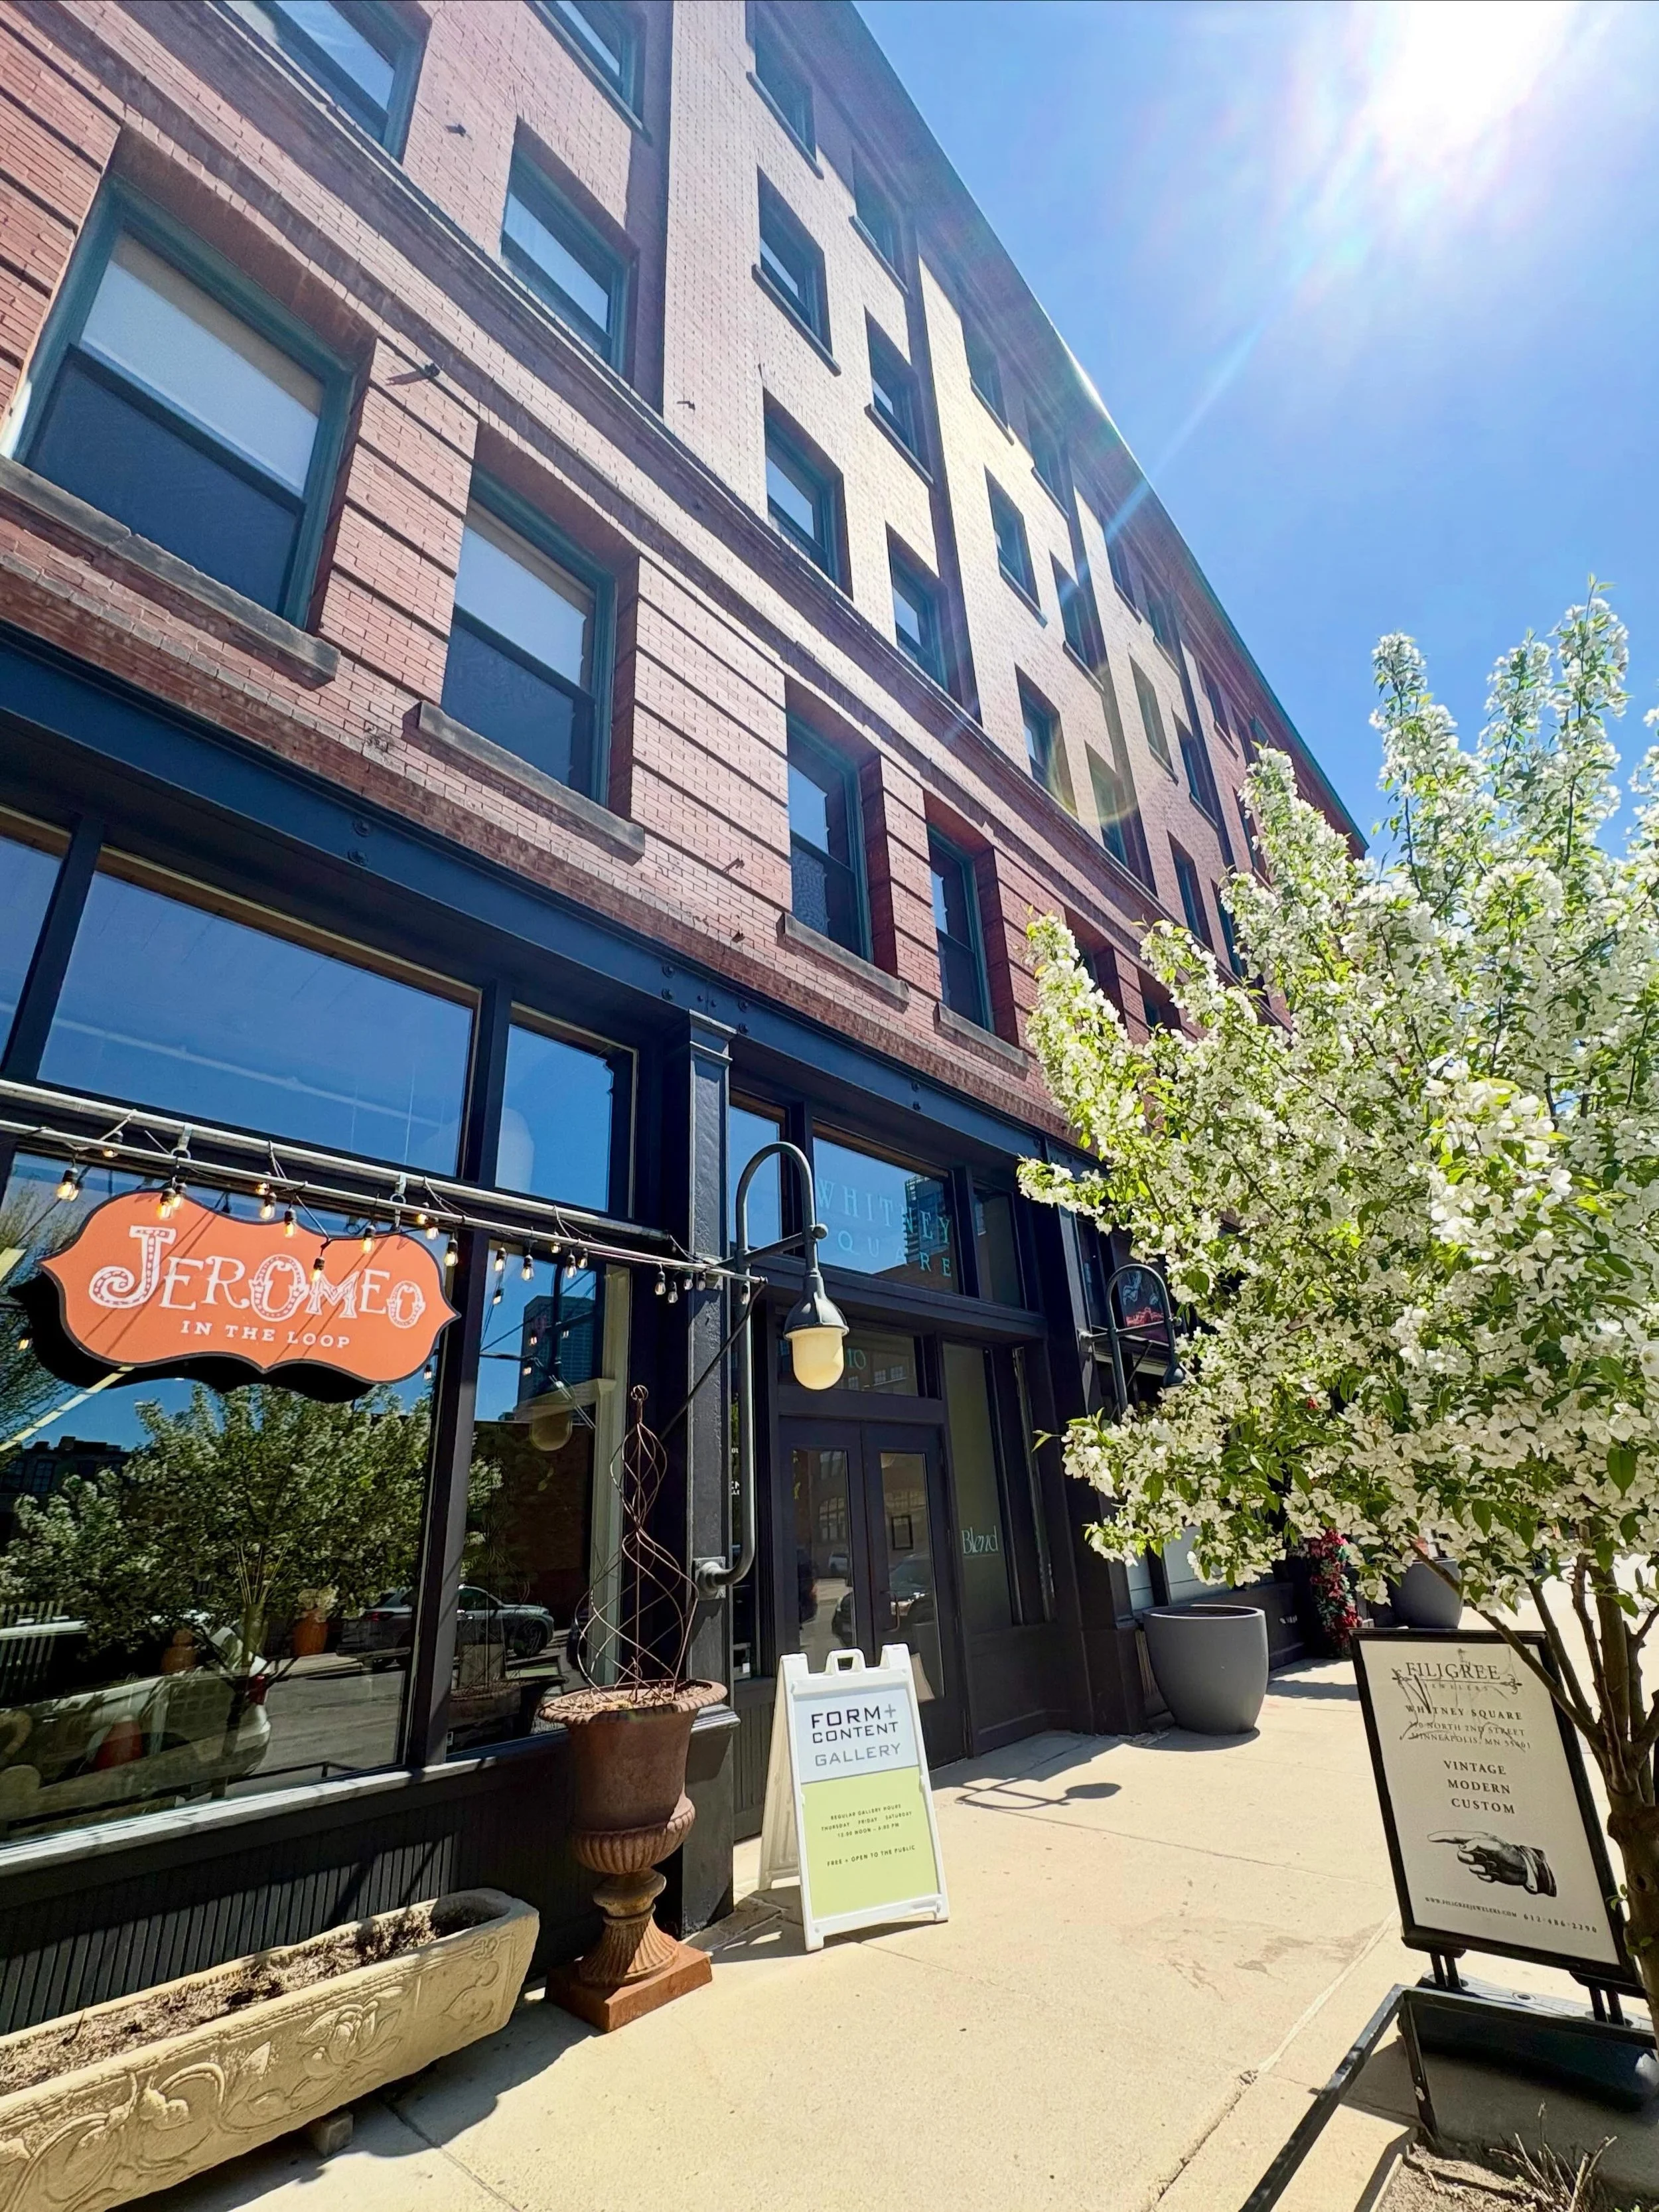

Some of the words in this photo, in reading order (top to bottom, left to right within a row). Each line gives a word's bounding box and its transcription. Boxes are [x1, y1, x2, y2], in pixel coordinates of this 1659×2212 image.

[817, 1178, 950, 1244] WHITNEY
[837, 1230, 952, 1278] QUARE
[88, 1225, 426, 1329] JEROMEO
[181, 1320, 212, 1335] IN
[226, 1325, 276, 1342] THE
[287, 1331, 351, 1349] LOOP
[962, 1525, 999, 1554] Blend
[1406, 1662, 1500, 1680] FILIGREE
[1406, 1705, 1463, 1716] WHTNEY
[1471, 1709, 1522, 1720] SQUARE
[812, 1722, 899, 1743] CONTENT
[1427, 1722, 1461, 1732] NORTH
[1488, 1726, 1525, 1736] STREET
[815, 1743, 901, 1767] GALLERY
[1443, 1760, 1506, 1775] VINTAGE
[1447, 1779, 1510, 1794] MODERN
[858, 1807, 881, 1816] GALLERY
[1451, 1798, 1514, 1814] CUSTOM
[822, 1822, 850, 1831] THURSDAY
[886, 1811, 912, 1820] SATURDAY
